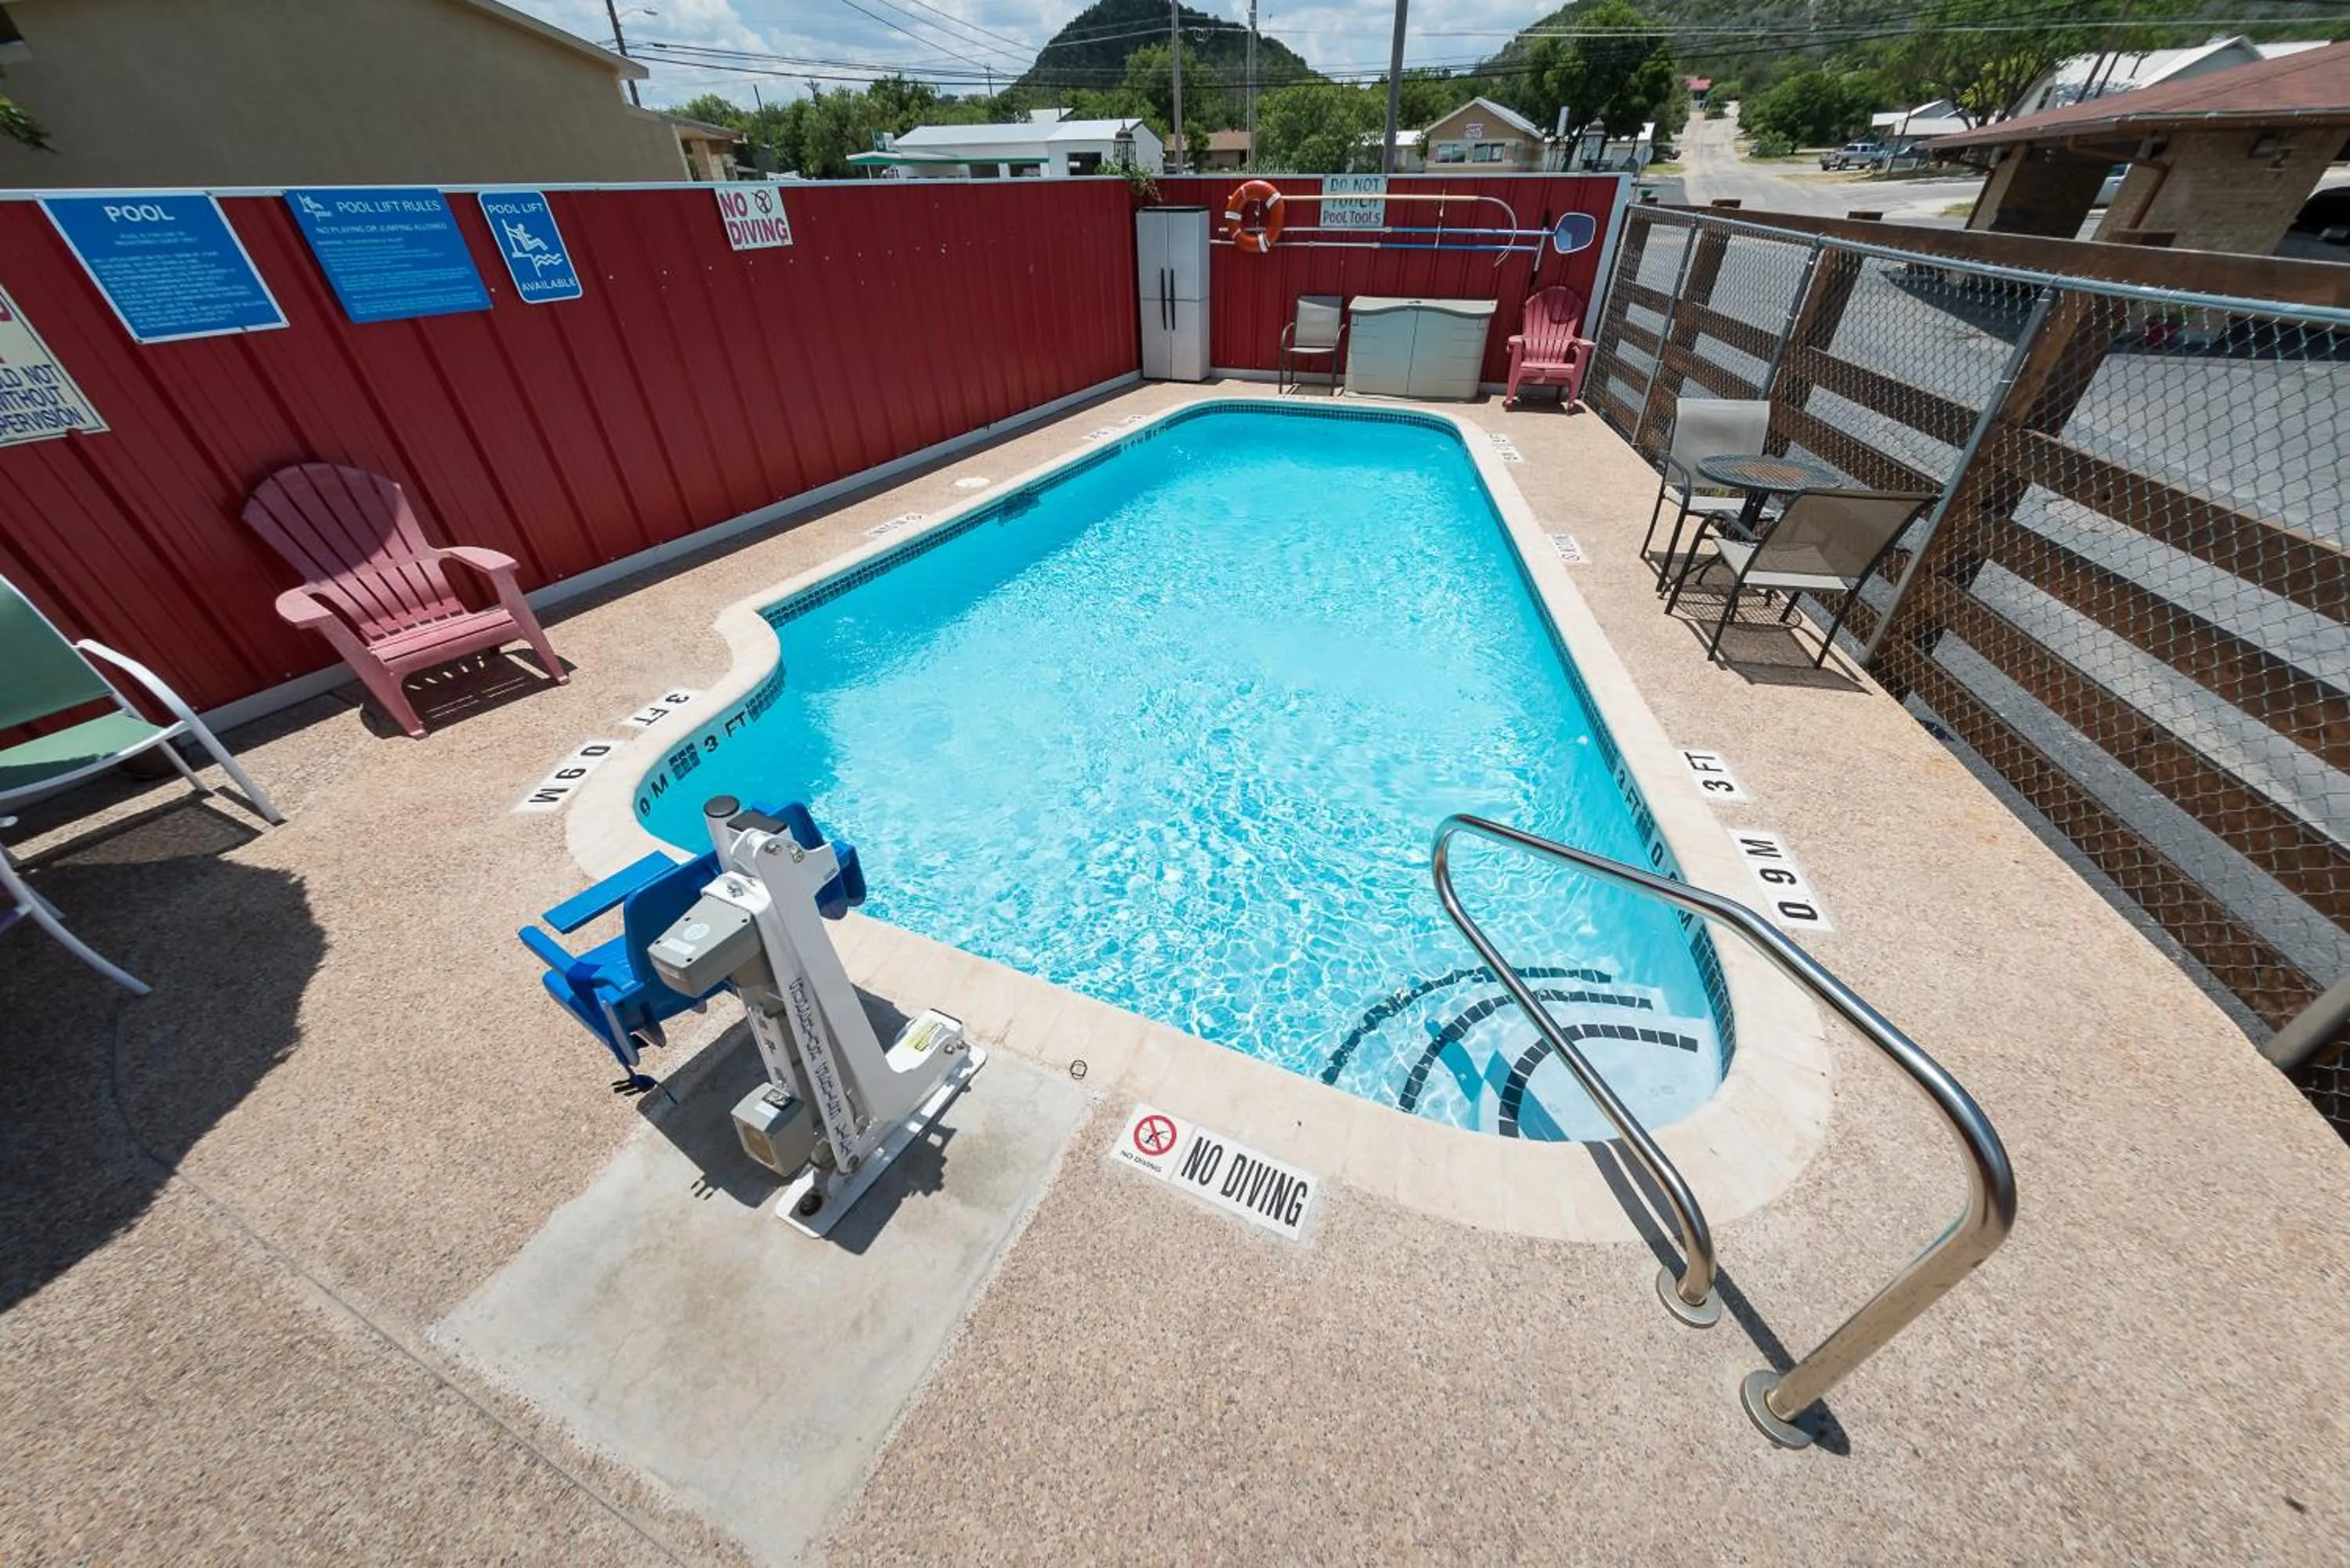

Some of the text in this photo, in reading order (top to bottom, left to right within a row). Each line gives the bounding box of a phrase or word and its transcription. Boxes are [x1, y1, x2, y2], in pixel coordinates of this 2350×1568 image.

[1353, 178, 1380, 192] NOT
[103, 204, 176, 223] POOL
[335, 200, 442, 214] POOL LIFT RULES
[486, 203, 544, 214] POOL LIFT
[718, 192, 748, 219] NO
[727, 217, 790, 245] DIVING
[522, 277, 577, 292] AVAILABLE
[0, 363, 61, 388] LD NOT
[0, 404, 87, 436] PERVISION
[633, 693, 690, 726] 3 FT
[703, 735, 719, 753] 3
[724, 710, 747, 738] FT
[1683, 751, 1735, 793] 3 FT
[1119, 1150, 1133, 1160] NO
[1180, 1136, 1309, 1227] NO DIVING
